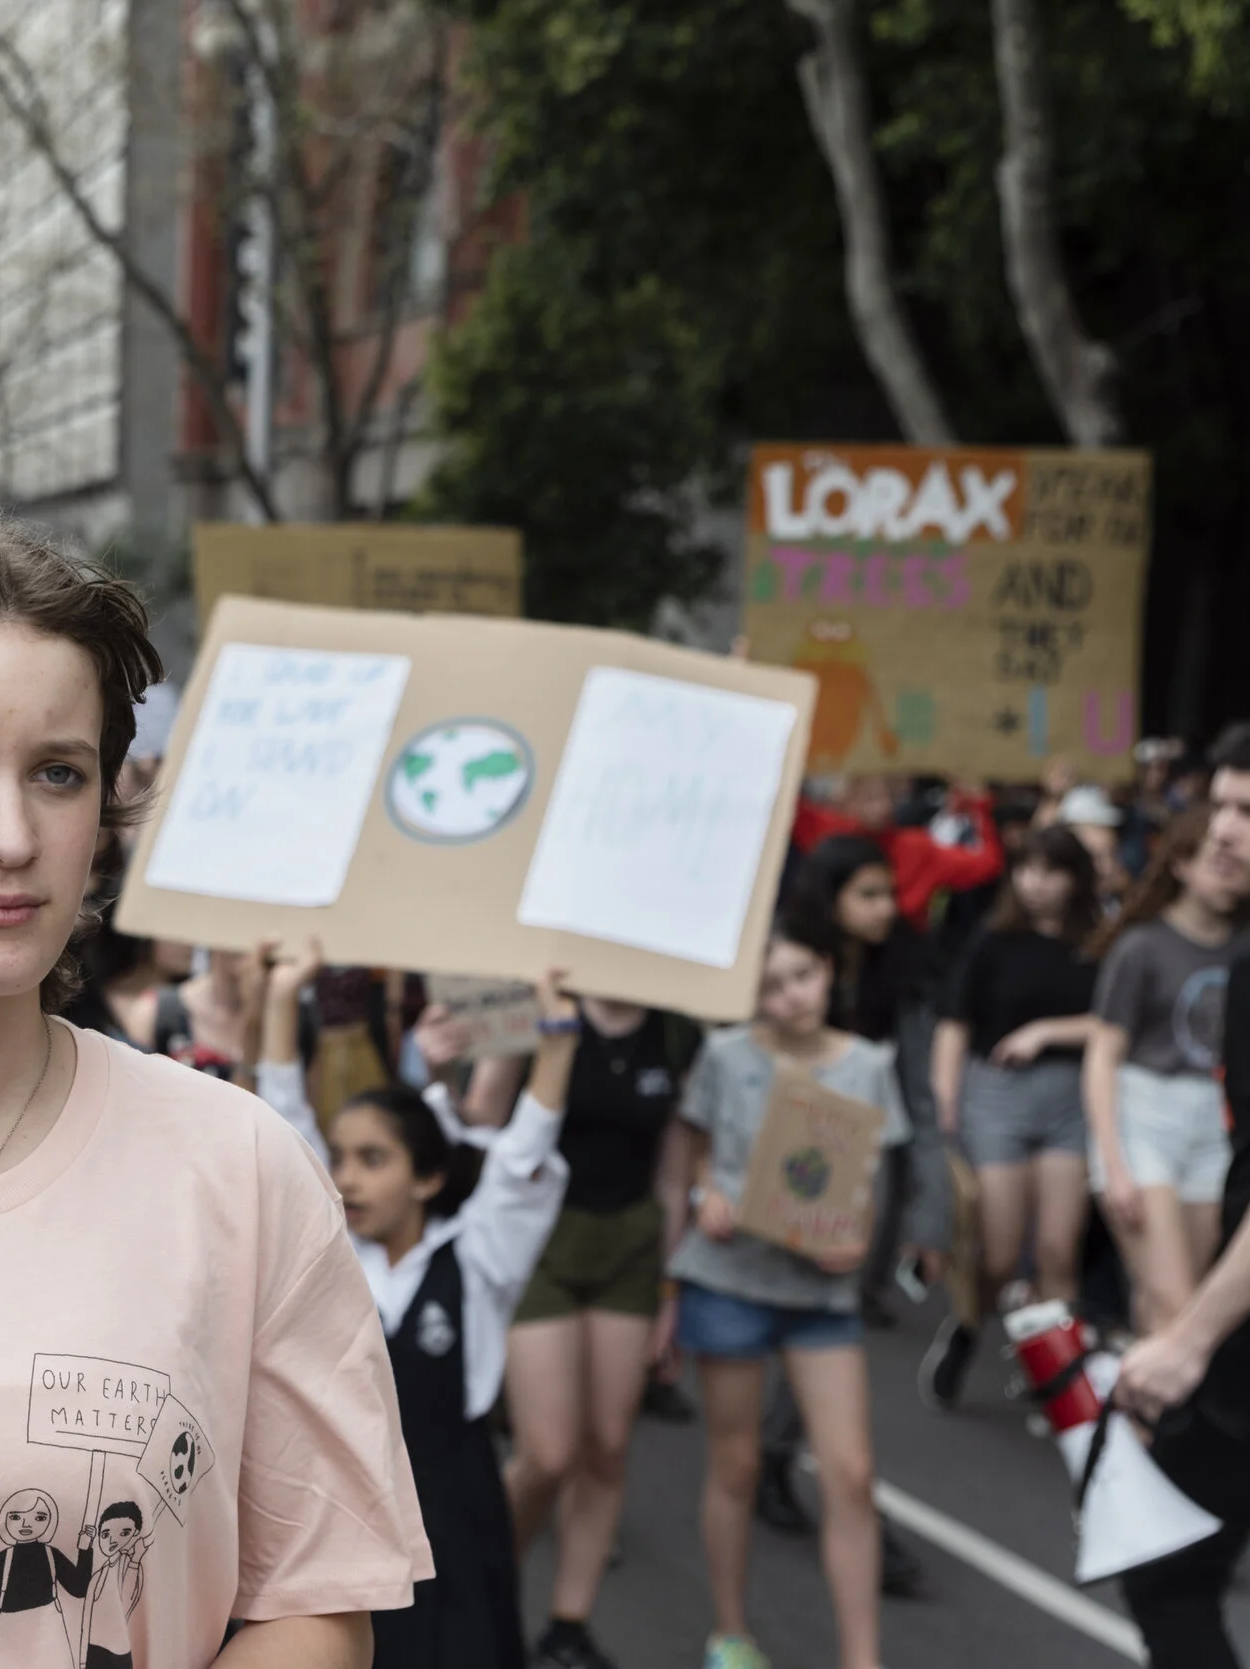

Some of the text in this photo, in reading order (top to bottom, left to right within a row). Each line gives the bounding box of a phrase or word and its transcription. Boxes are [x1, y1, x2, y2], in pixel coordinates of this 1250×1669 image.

[761, 461, 1017, 544] LORAX
[767, 546, 971, 608] TREES
[991, 560, 1095, 613] AND
[247, 736, 354, 777] STAND
[42, 1369, 166, 1407] OUR EARTH
